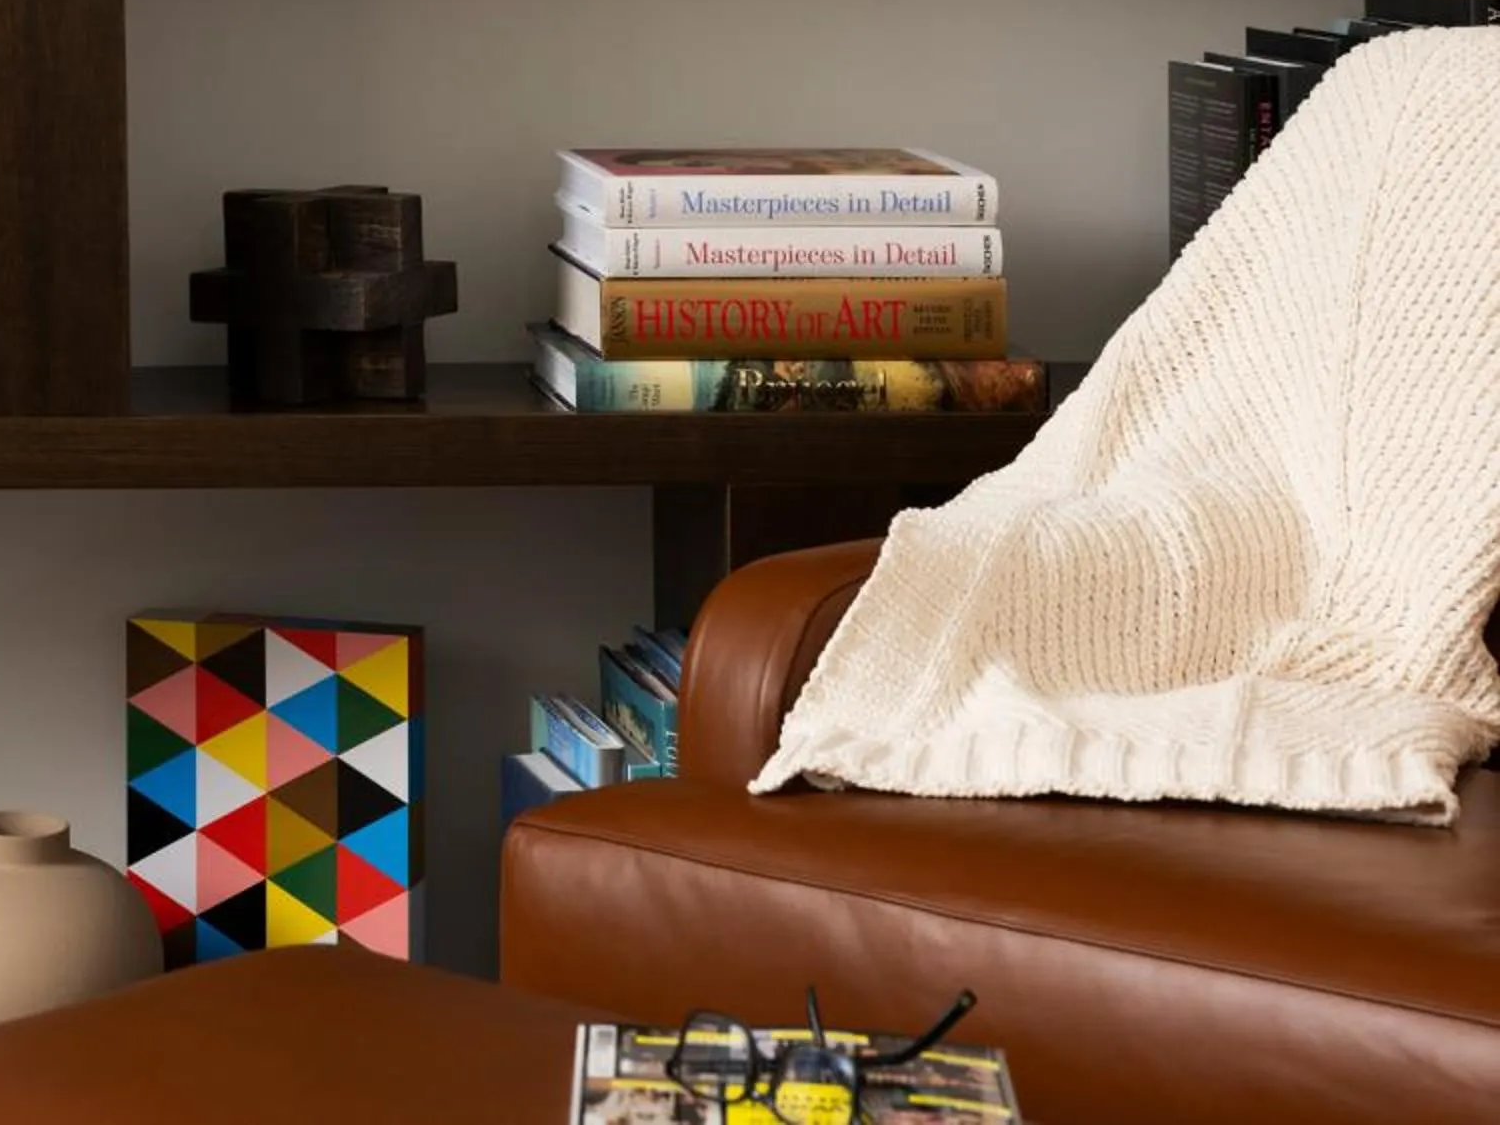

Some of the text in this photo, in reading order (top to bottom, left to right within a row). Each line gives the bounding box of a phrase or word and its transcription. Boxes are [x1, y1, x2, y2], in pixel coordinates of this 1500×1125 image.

[681, 190, 952, 222] Masterpieces in Detail
[686, 242, 957, 271] Masterpieces in Detail
[633, 299, 793, 343] HISTORY
[798, 311, 828, 338] OF
[835, 297, 907, 343] ART
